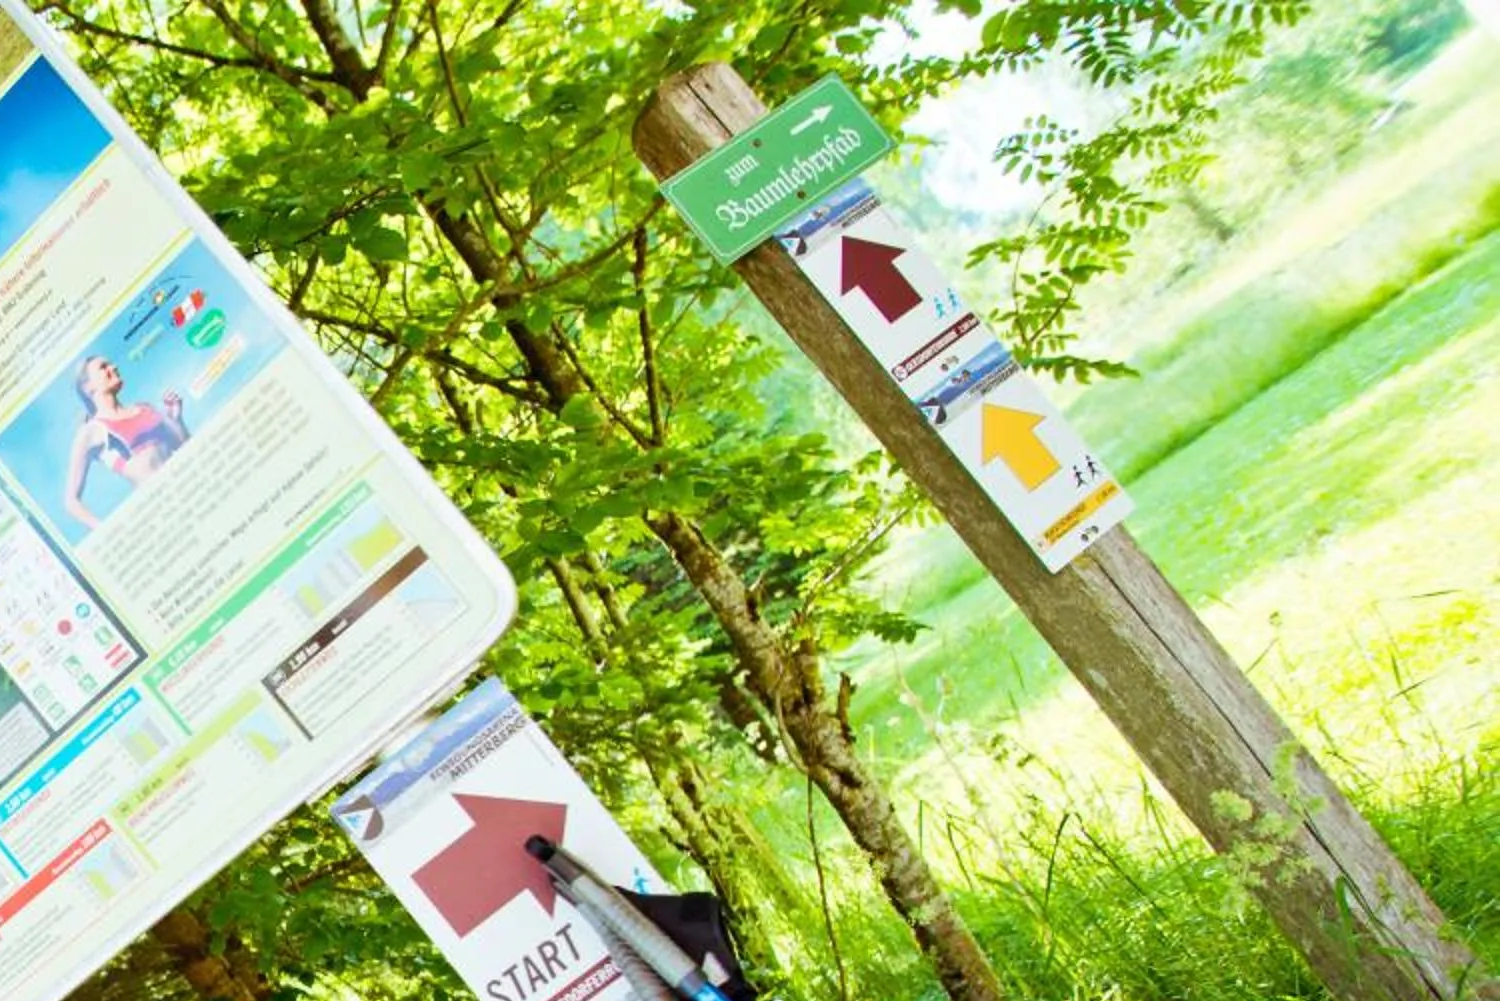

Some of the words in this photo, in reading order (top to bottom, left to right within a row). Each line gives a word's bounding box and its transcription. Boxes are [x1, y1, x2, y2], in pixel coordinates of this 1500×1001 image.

[715, 126, 862, 231] Baumlehrpfad
[725, 155, 760, 185] zum
[448, 714, 528, 782] MITTERBERG
